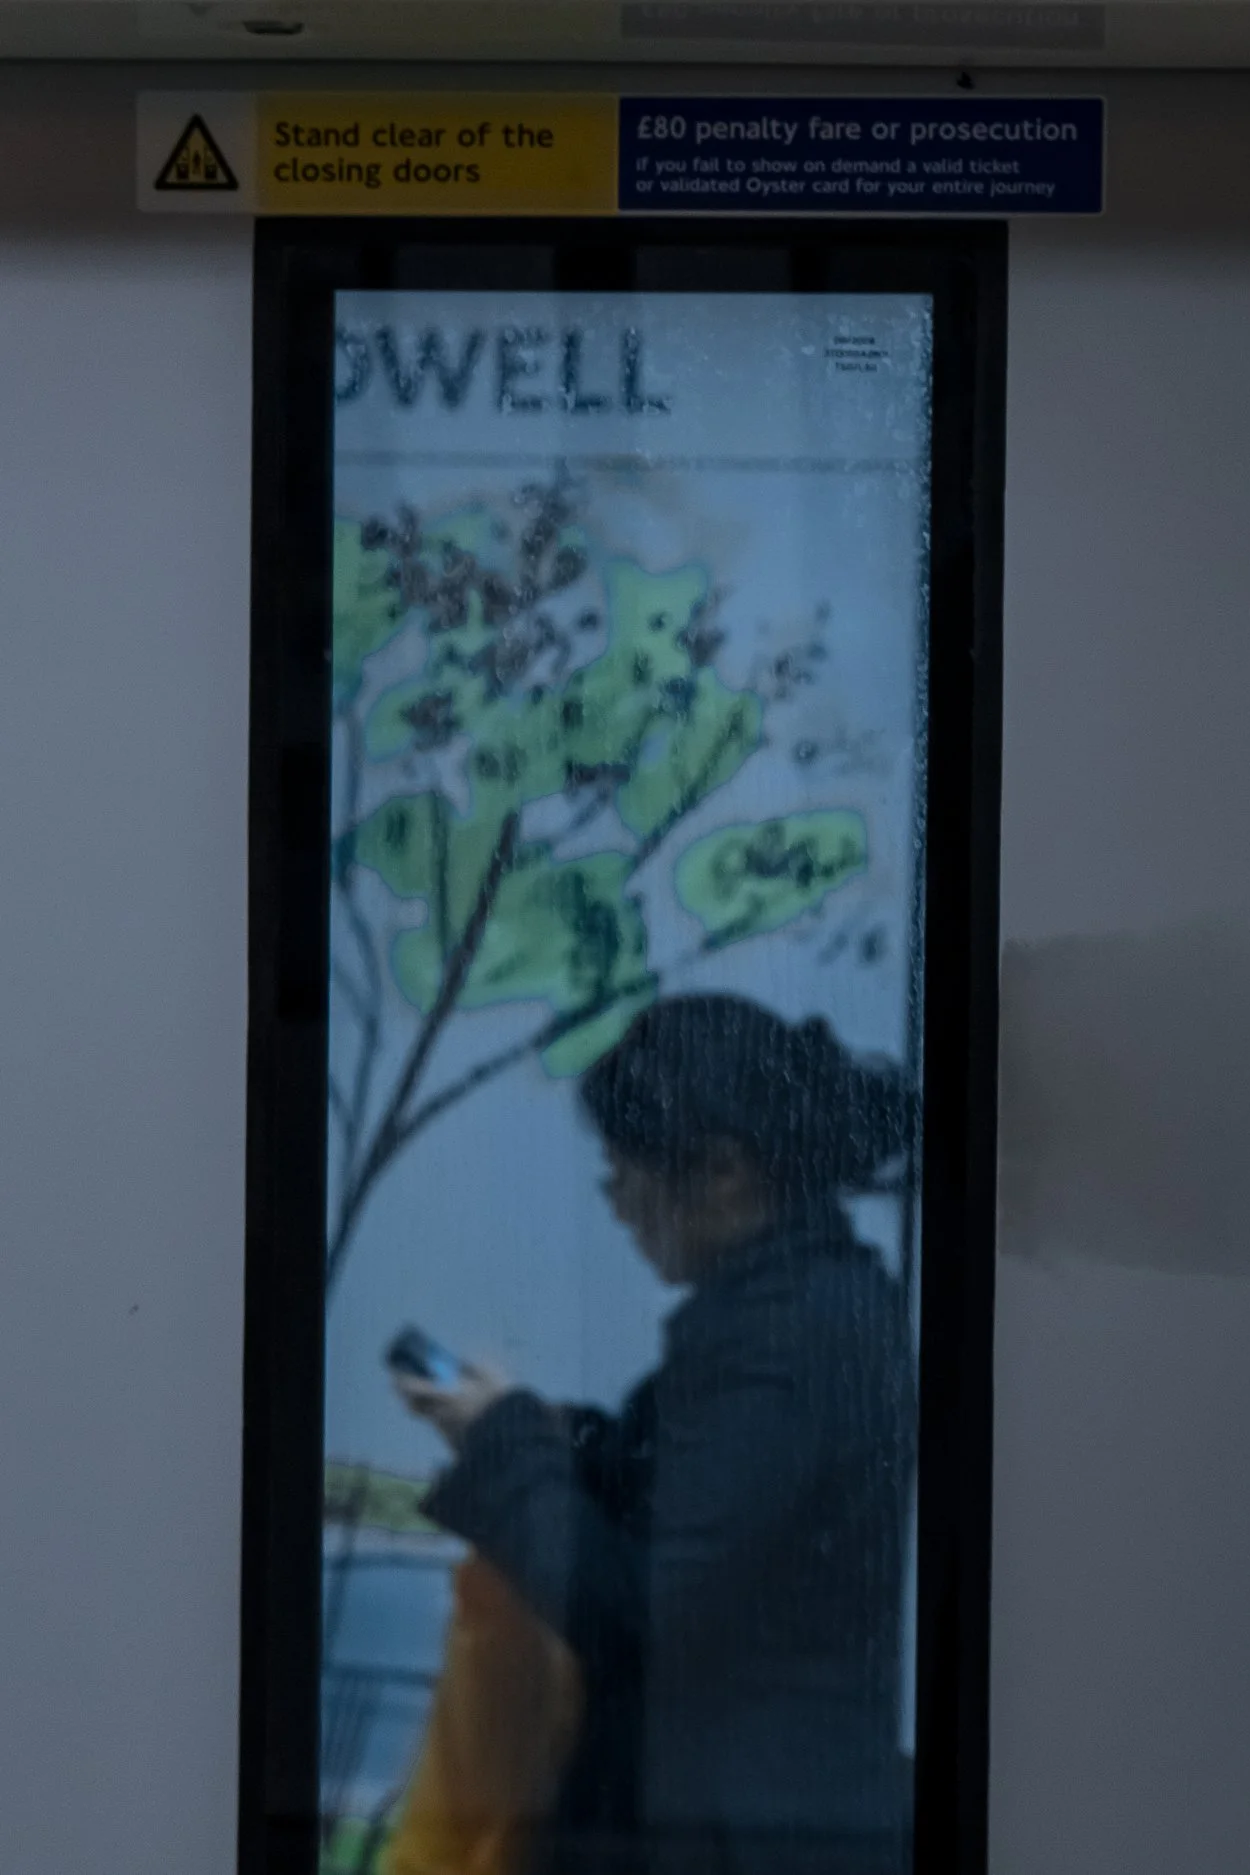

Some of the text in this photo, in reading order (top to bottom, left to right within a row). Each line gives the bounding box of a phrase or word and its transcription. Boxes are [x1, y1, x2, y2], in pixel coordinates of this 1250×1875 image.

[274, 121, 554, 148] Stand clear of the
[637, 117, 1077, 145] £80 penalty fare or prosecution
[274, 157, 480, 189] closing doors
[655, 160, 687, 175] you
[693, 157, 720, 173] fail
[726, 159, 745, 173] to
[753, 158, 797, 173] show
[804, 161, 826, 173] on
[832, 158, 901, 173] demand
[908, 162, 917, 173] a
[923, 158, 964, 173] valid
[969, 158, 1020, 174] ticket
[636, 177, 1055, 197] or validated Oyster card for your entire journey
